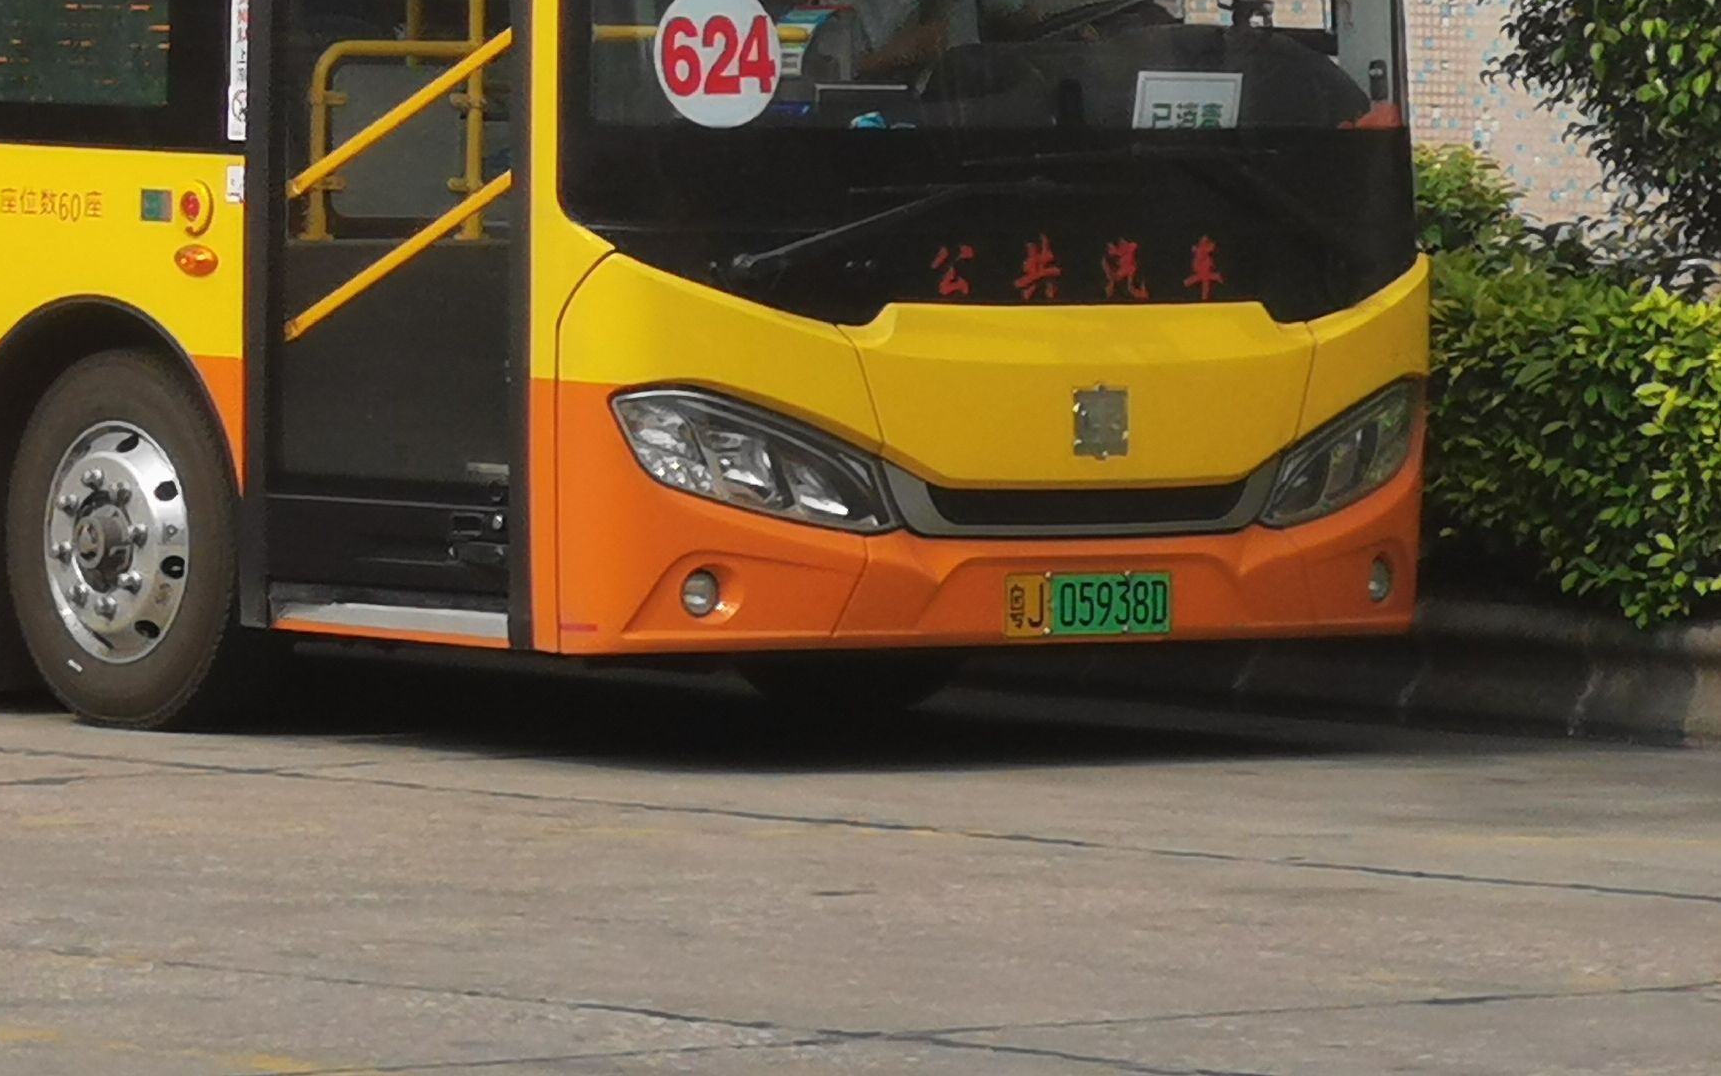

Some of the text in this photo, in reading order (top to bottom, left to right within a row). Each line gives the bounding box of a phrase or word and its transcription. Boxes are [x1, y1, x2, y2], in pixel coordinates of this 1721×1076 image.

[662, 15, 776, 97] 624
[0, 188, 103, 223] 座位数60座
[930, 233, 1225, 301] 公共汽车
